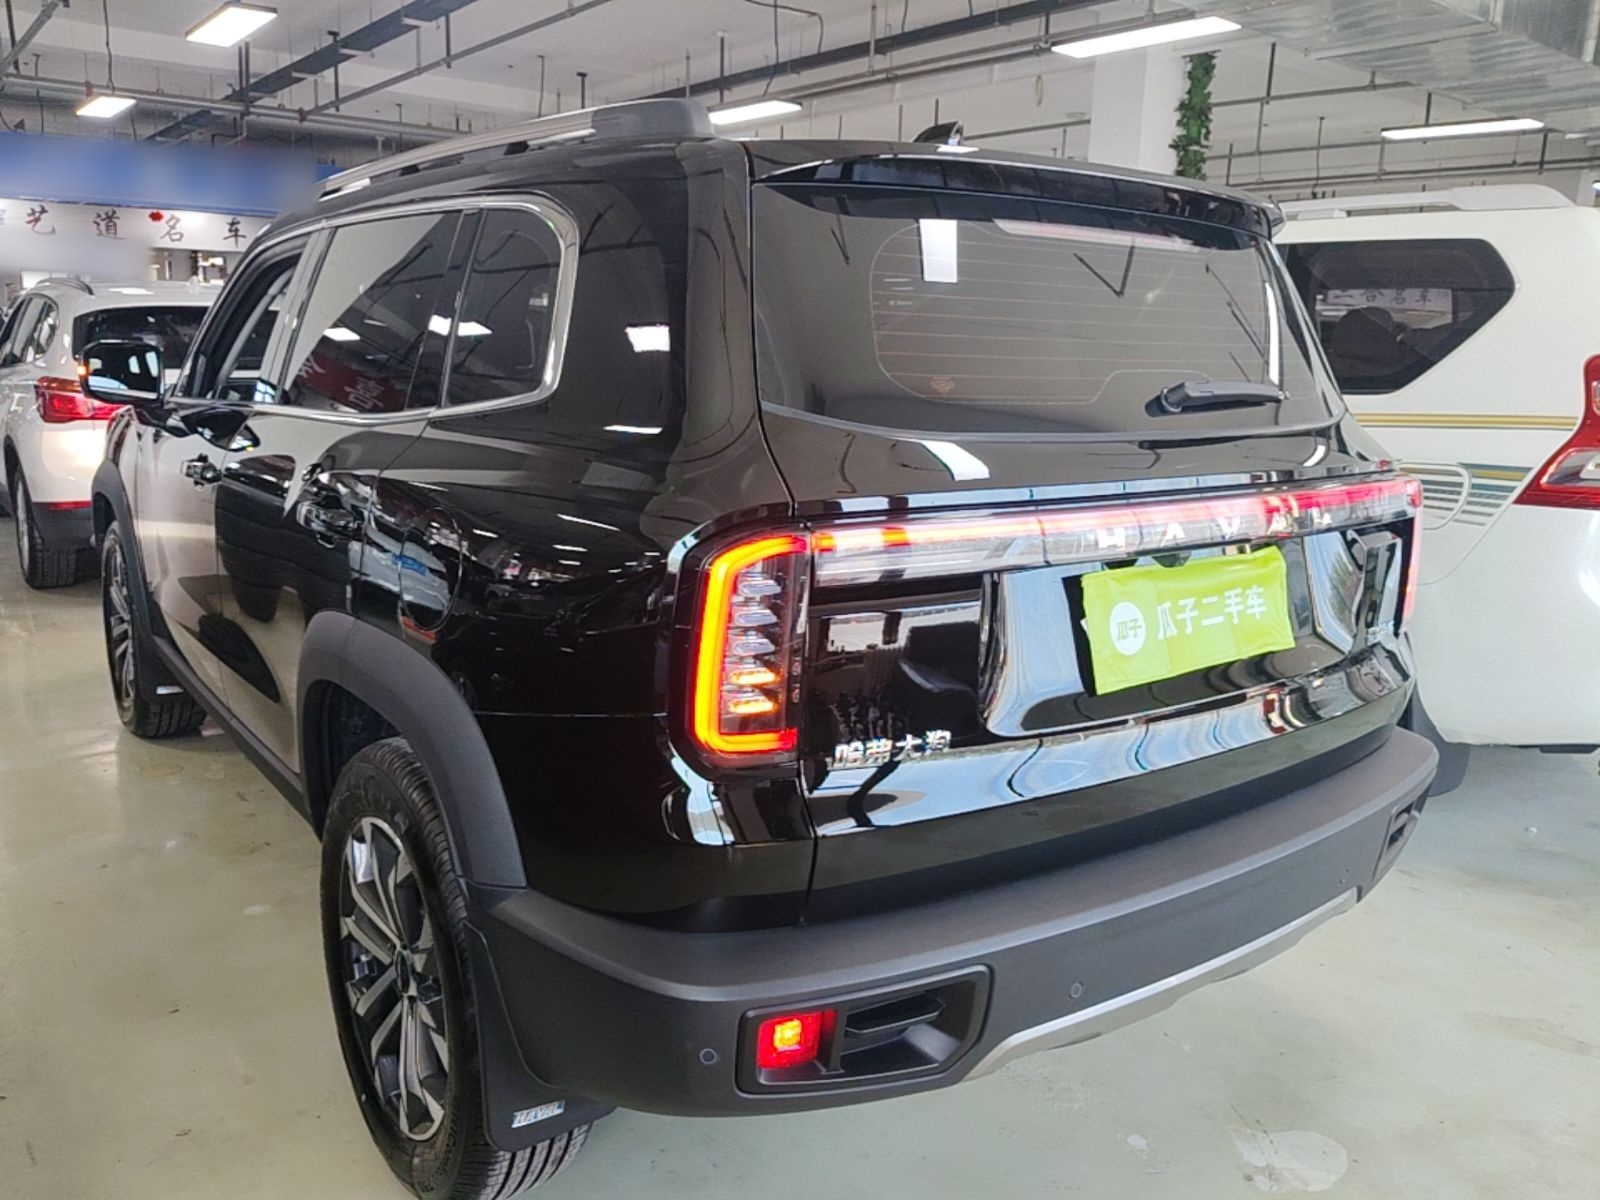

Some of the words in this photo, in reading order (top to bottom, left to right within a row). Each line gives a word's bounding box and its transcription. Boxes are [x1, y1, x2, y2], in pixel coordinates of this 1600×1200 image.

[0, 204, 247, 248] 艺道名车
[1115, 617, 1142, 642] 瓜子
[1156, 584, 1267, 641] 瓜子二手车
